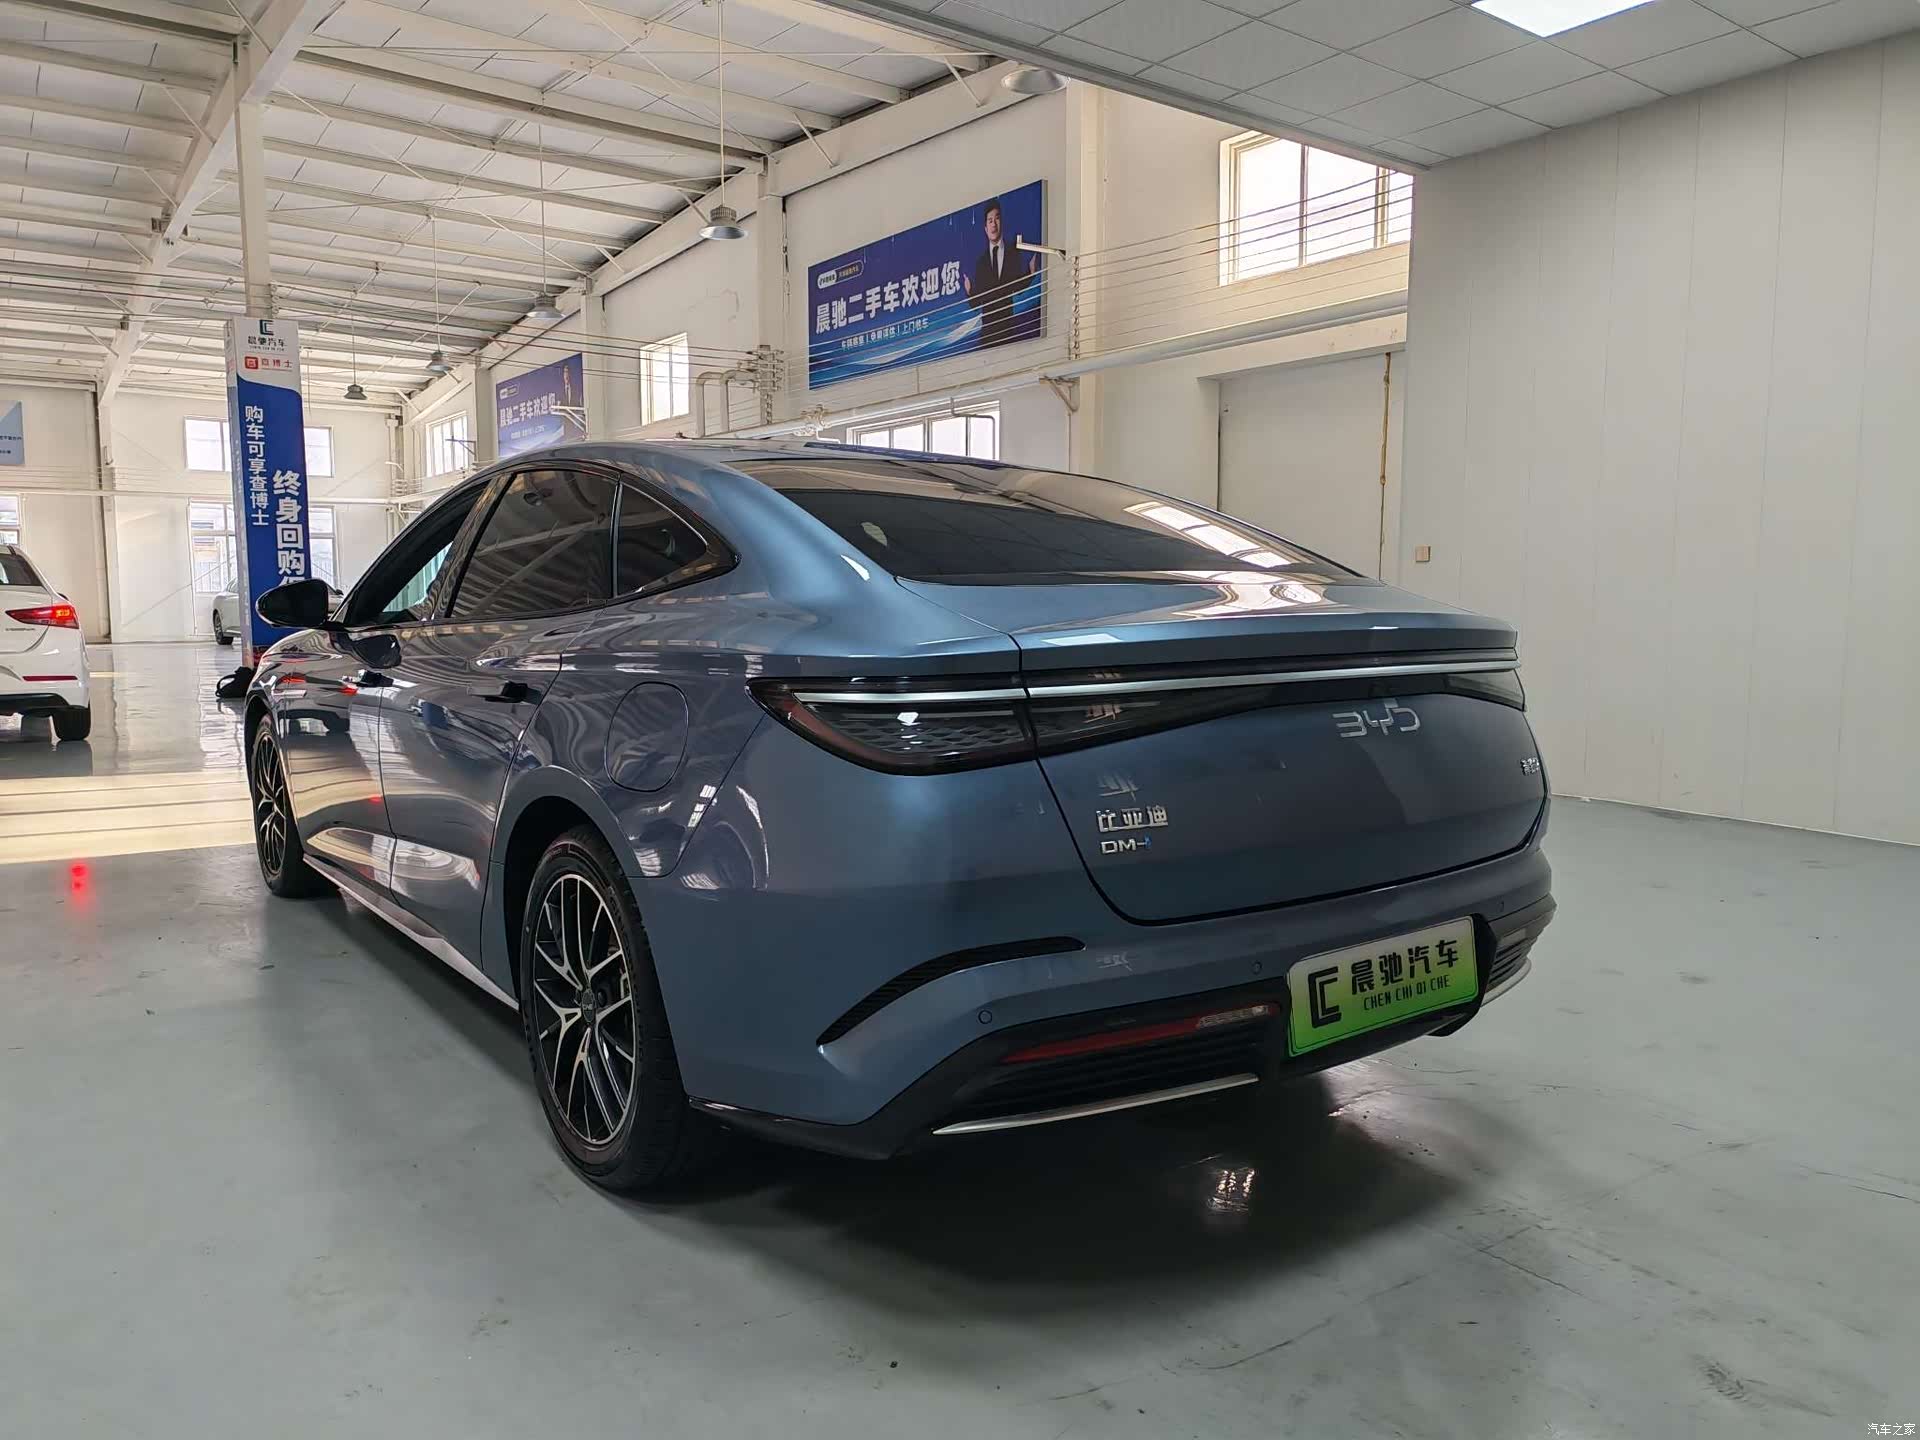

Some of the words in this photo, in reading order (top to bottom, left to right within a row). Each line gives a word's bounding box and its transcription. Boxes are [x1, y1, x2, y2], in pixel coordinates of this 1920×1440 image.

[816, 260, 961, 334] 晨驰二手车欢迎您
[245, 405, 269, 527] 购车可享查博士
[1332, 704, 1421, 738] BYD
[1096, 805, 1168, 832] 比亚迪
[1351, 940, 1459, 995] 晨驰汽车
[1363, 992, 1391, 1011] CHEN
[1396, 986, 1412, 1001] CHI
[1416, 980, 1426, 994] QI
[1430, 975, 1451, 991] CHE
